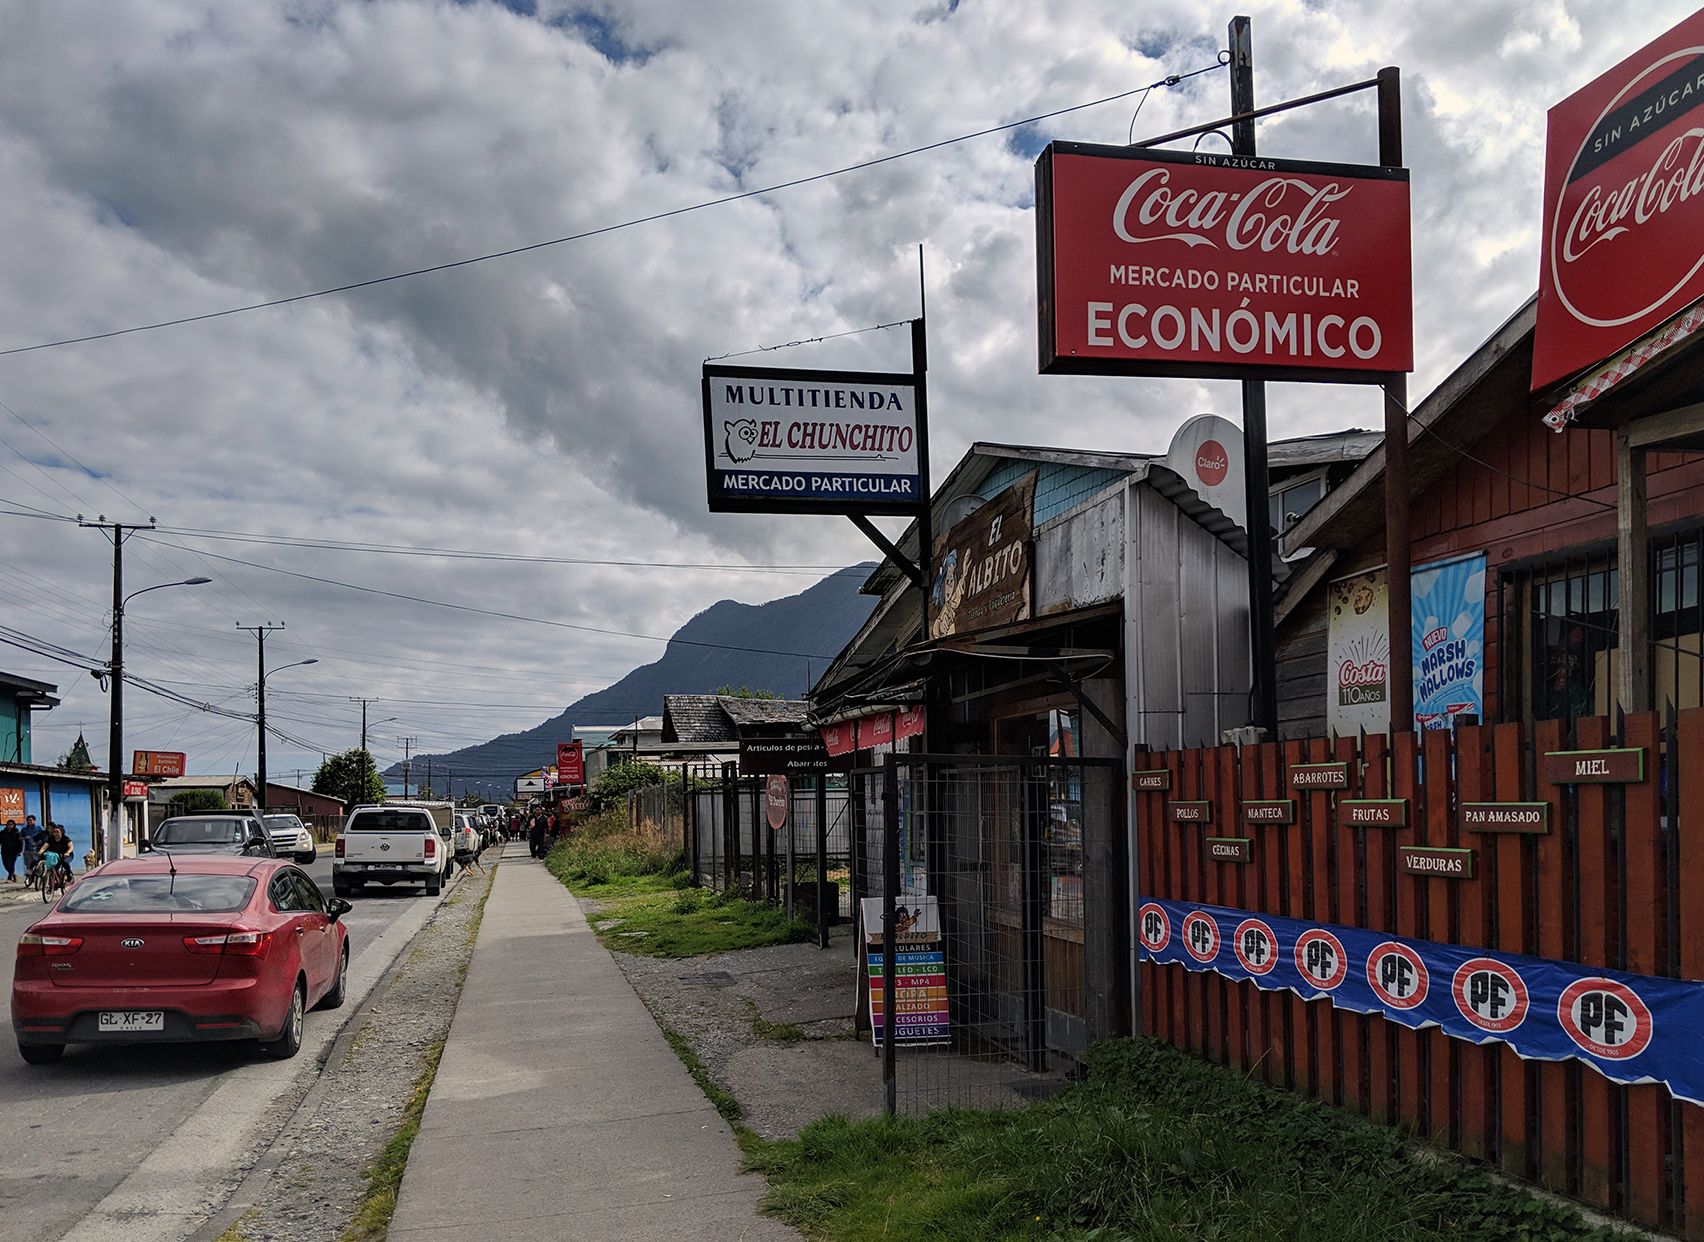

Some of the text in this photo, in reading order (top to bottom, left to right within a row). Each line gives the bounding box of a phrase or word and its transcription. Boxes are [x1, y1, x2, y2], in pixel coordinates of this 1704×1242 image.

[1594, 73, 1704, 153] SIN AZÚCAR
[1195, 154, 1276, 171] SIN AZÚCAR
[1113, 168, 1354, 256] Coca-Cola
[1110, 264, 1360, 299] MERCADO PARTICULAR
[1087, 297, 1382, 360] ECONÓMICO
[725, 384, 904, 411] MULTITIENDA
[757, 421, 914, 453] EL CHUNCHITO
[1197, 456, 1221, 470] Claro
[723, 474, 912, 493] MERCADO PARTICULAR
[987, 514, 1003, 547] EL
[967, 539, 1023, 599] ALBITO
[1424, 628, 1448, 650] NUEVO
[1421, 638, 1467, 678] MARSH
[1339, 660, 1386, 687] Costa
[1419, 660, 1476, 703] MALLOWS
[785, 744, 796, 752] de
[154, 765, 180, 773] El Chile
[1293, 771, 1345, 784] ABARROTES
[1575, 759, 1610, 777] MIEL
[1139, 777, 1162, 787] CARNES
[1176, 808, 1199, 819] POLLOS
[1248, 808, 1283, 819] MANTECA
[1352, 808, 1390, 822] FRUTAS
[1465, 811, 1541, 824] PAN AMASADO
[1212, 845, 1240, 856] CECINAS
[1406, 855, 1463, 873] VERDURAS
[1144, 912, 1162, 943] PF
[1191, 921, 1212, 953] PF
[124, 939, 140, 947] KIA
[1244, 929, 1267, 965] PF
[922, 965, 938, 973] LCD
[1307, 940, 1334, 979] PF
[1381, 954, 1413, 998] PF
[1470, 972, 1510, 1019] PF
[895, 1003, 930, 1011] ALZADO
[896, 1015, 938, 1023] CESORIOS
[1580, 992, 1629, 1045] PF
[1589, 1044, 1606, 1055] DESDE
